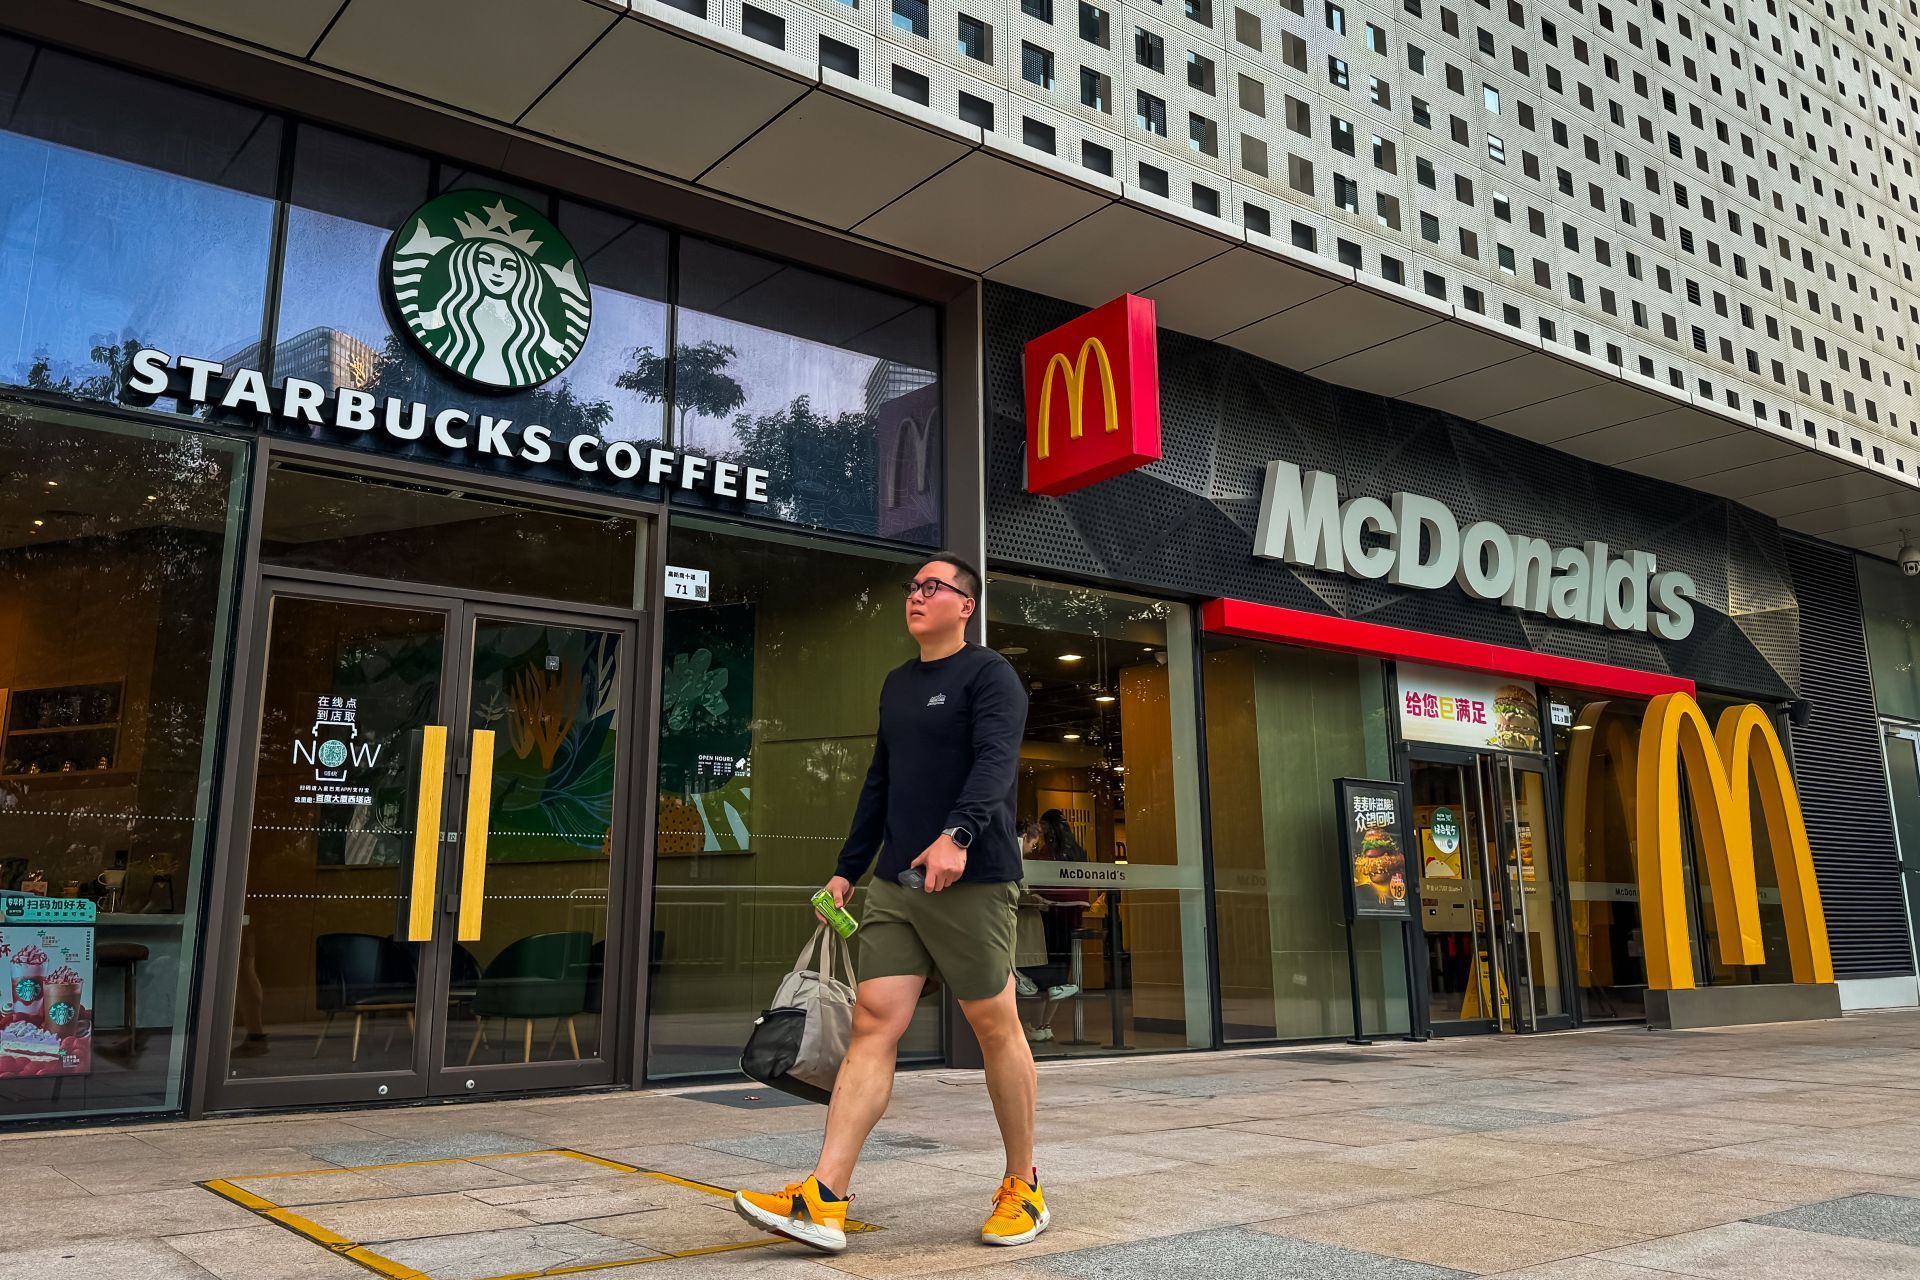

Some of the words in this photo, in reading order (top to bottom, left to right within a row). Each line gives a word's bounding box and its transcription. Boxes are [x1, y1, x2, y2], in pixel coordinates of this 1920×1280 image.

[128, 348, 552, 464] STARBUCKS
[567, 433, 769, 504] COFFEE
[1252, 459, 1697, 642] McDonald's
[675, 583, 688, 595] 71
[317, 696, 357, 709] 在线点
[1405, 690, 1487, 725] 给您巨满足
[316, 709, 356, 722] 到店取
[714, 755, 734, 763] HOURS
[1355, 811, 1396, 832] 众望回归
[1059, 868, 1126, 881] McDonald's
[27, 900, 87, 910] 扫码加好友
